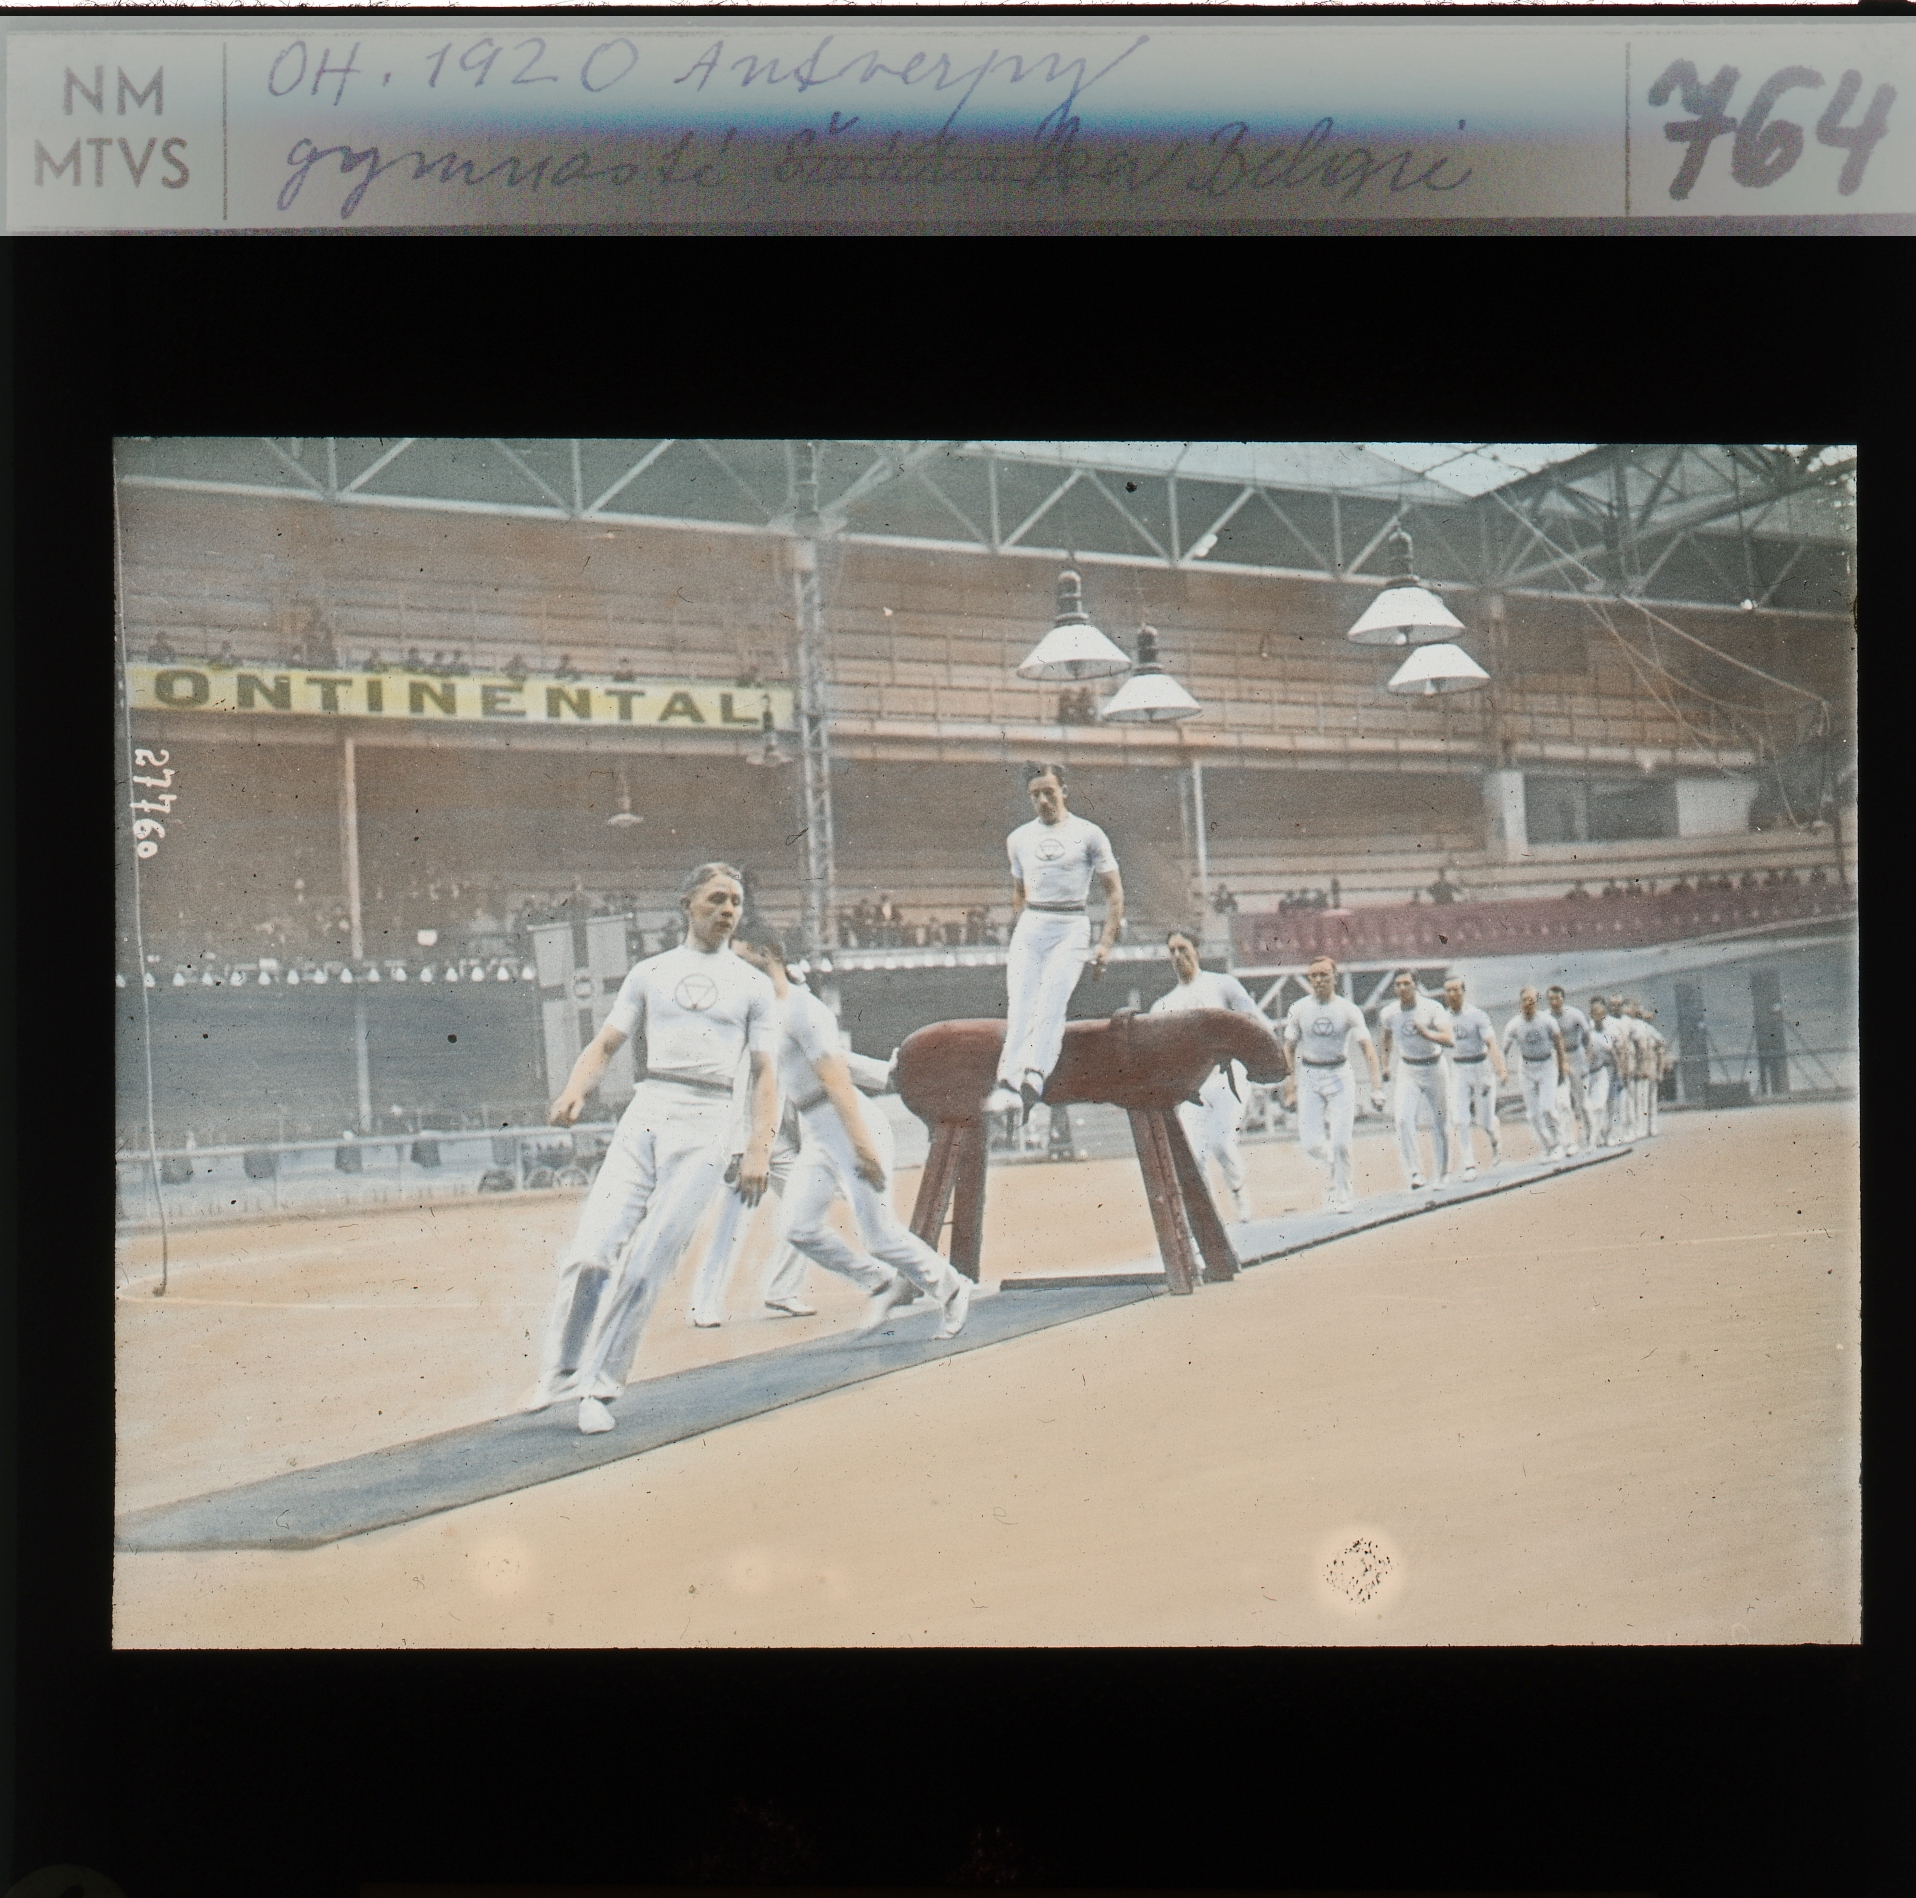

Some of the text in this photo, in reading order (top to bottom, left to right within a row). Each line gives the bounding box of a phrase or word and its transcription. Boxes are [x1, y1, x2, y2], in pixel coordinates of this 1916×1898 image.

[63, 64, 165, 117] NM
[424, 36, 640, 93] 1920
[1647, 58, 1898, 201] 764
[33, 136, 190, 190] MTVS
[154, 668, 760, 724] ONTINENTAL
[130, 748, 177, 859] 27760
